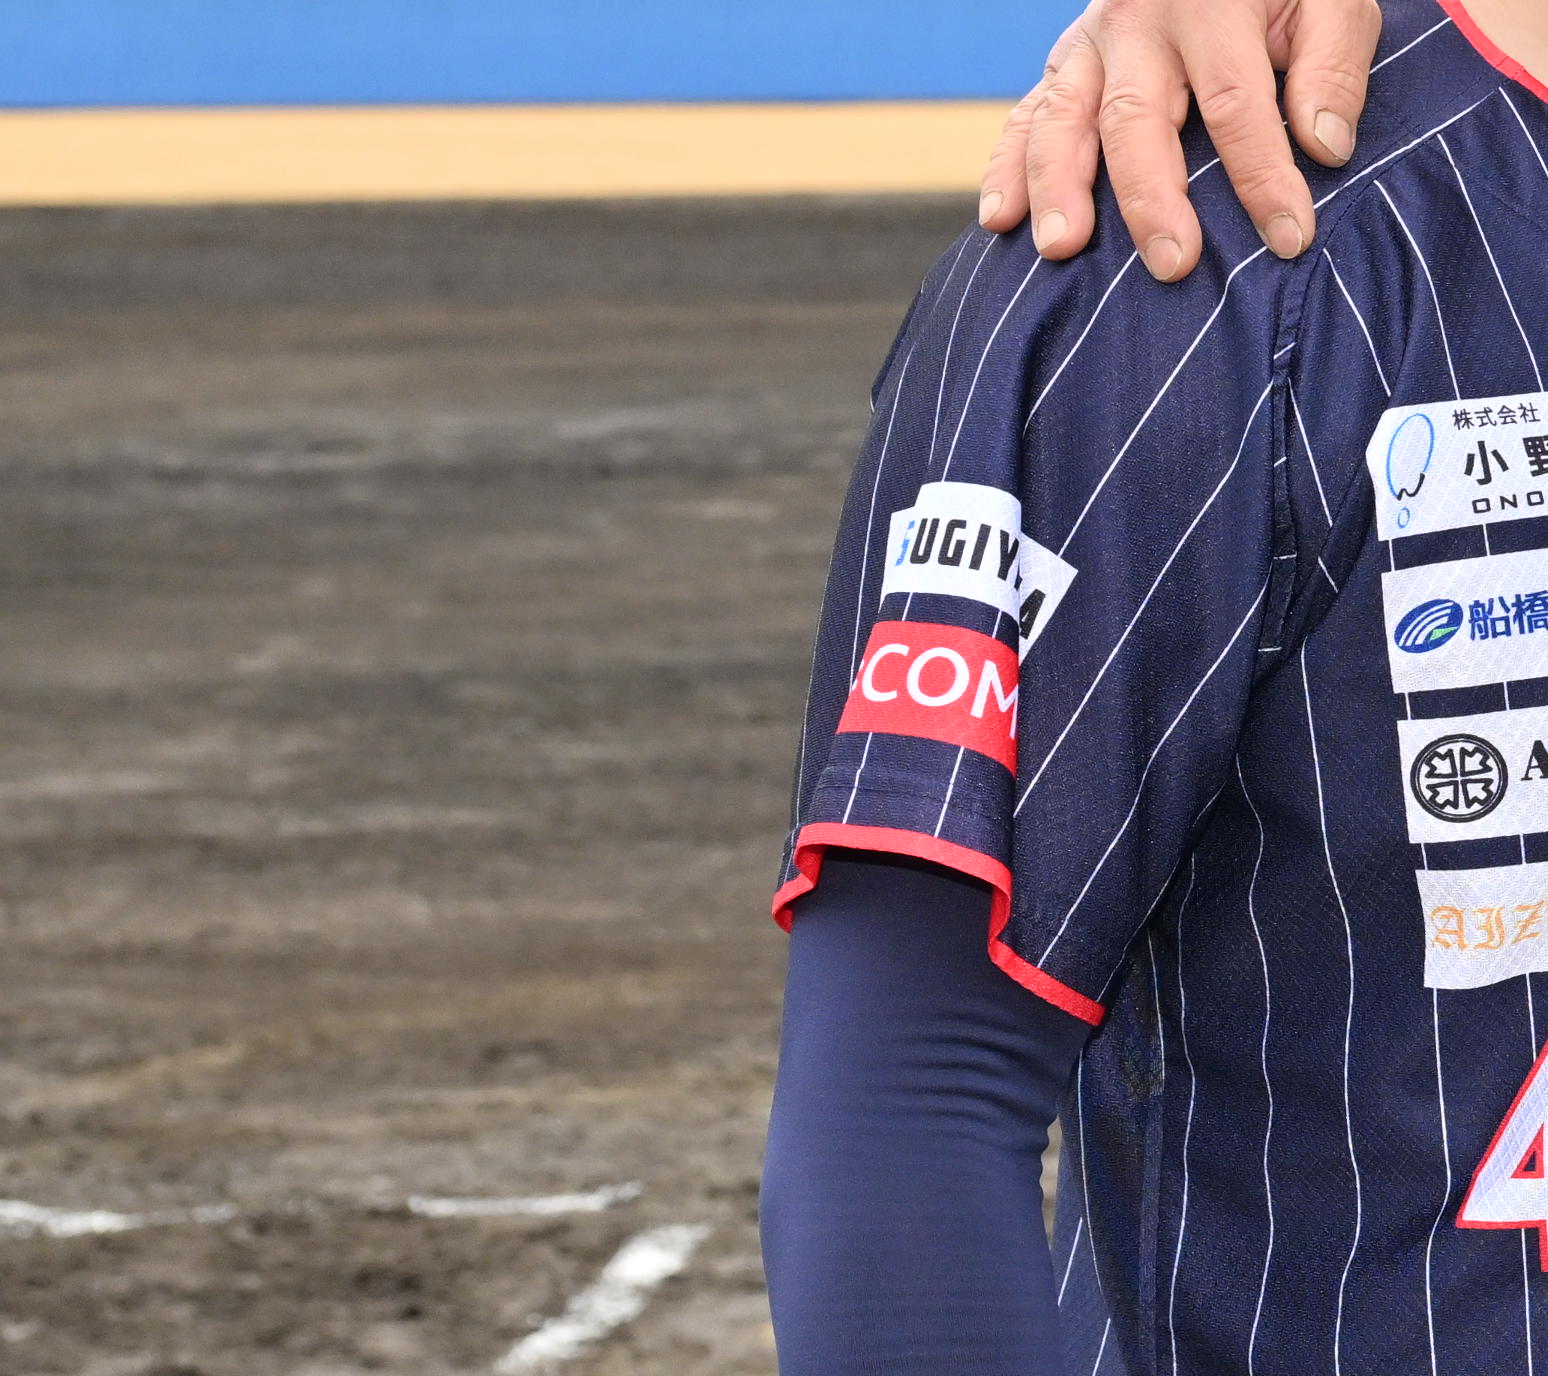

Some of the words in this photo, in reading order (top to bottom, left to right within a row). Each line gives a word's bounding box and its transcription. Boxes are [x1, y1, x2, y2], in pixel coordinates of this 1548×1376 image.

[1452, 402, 1541, 431] 株式会社
[1471, 489, 1545, 515] ONO
